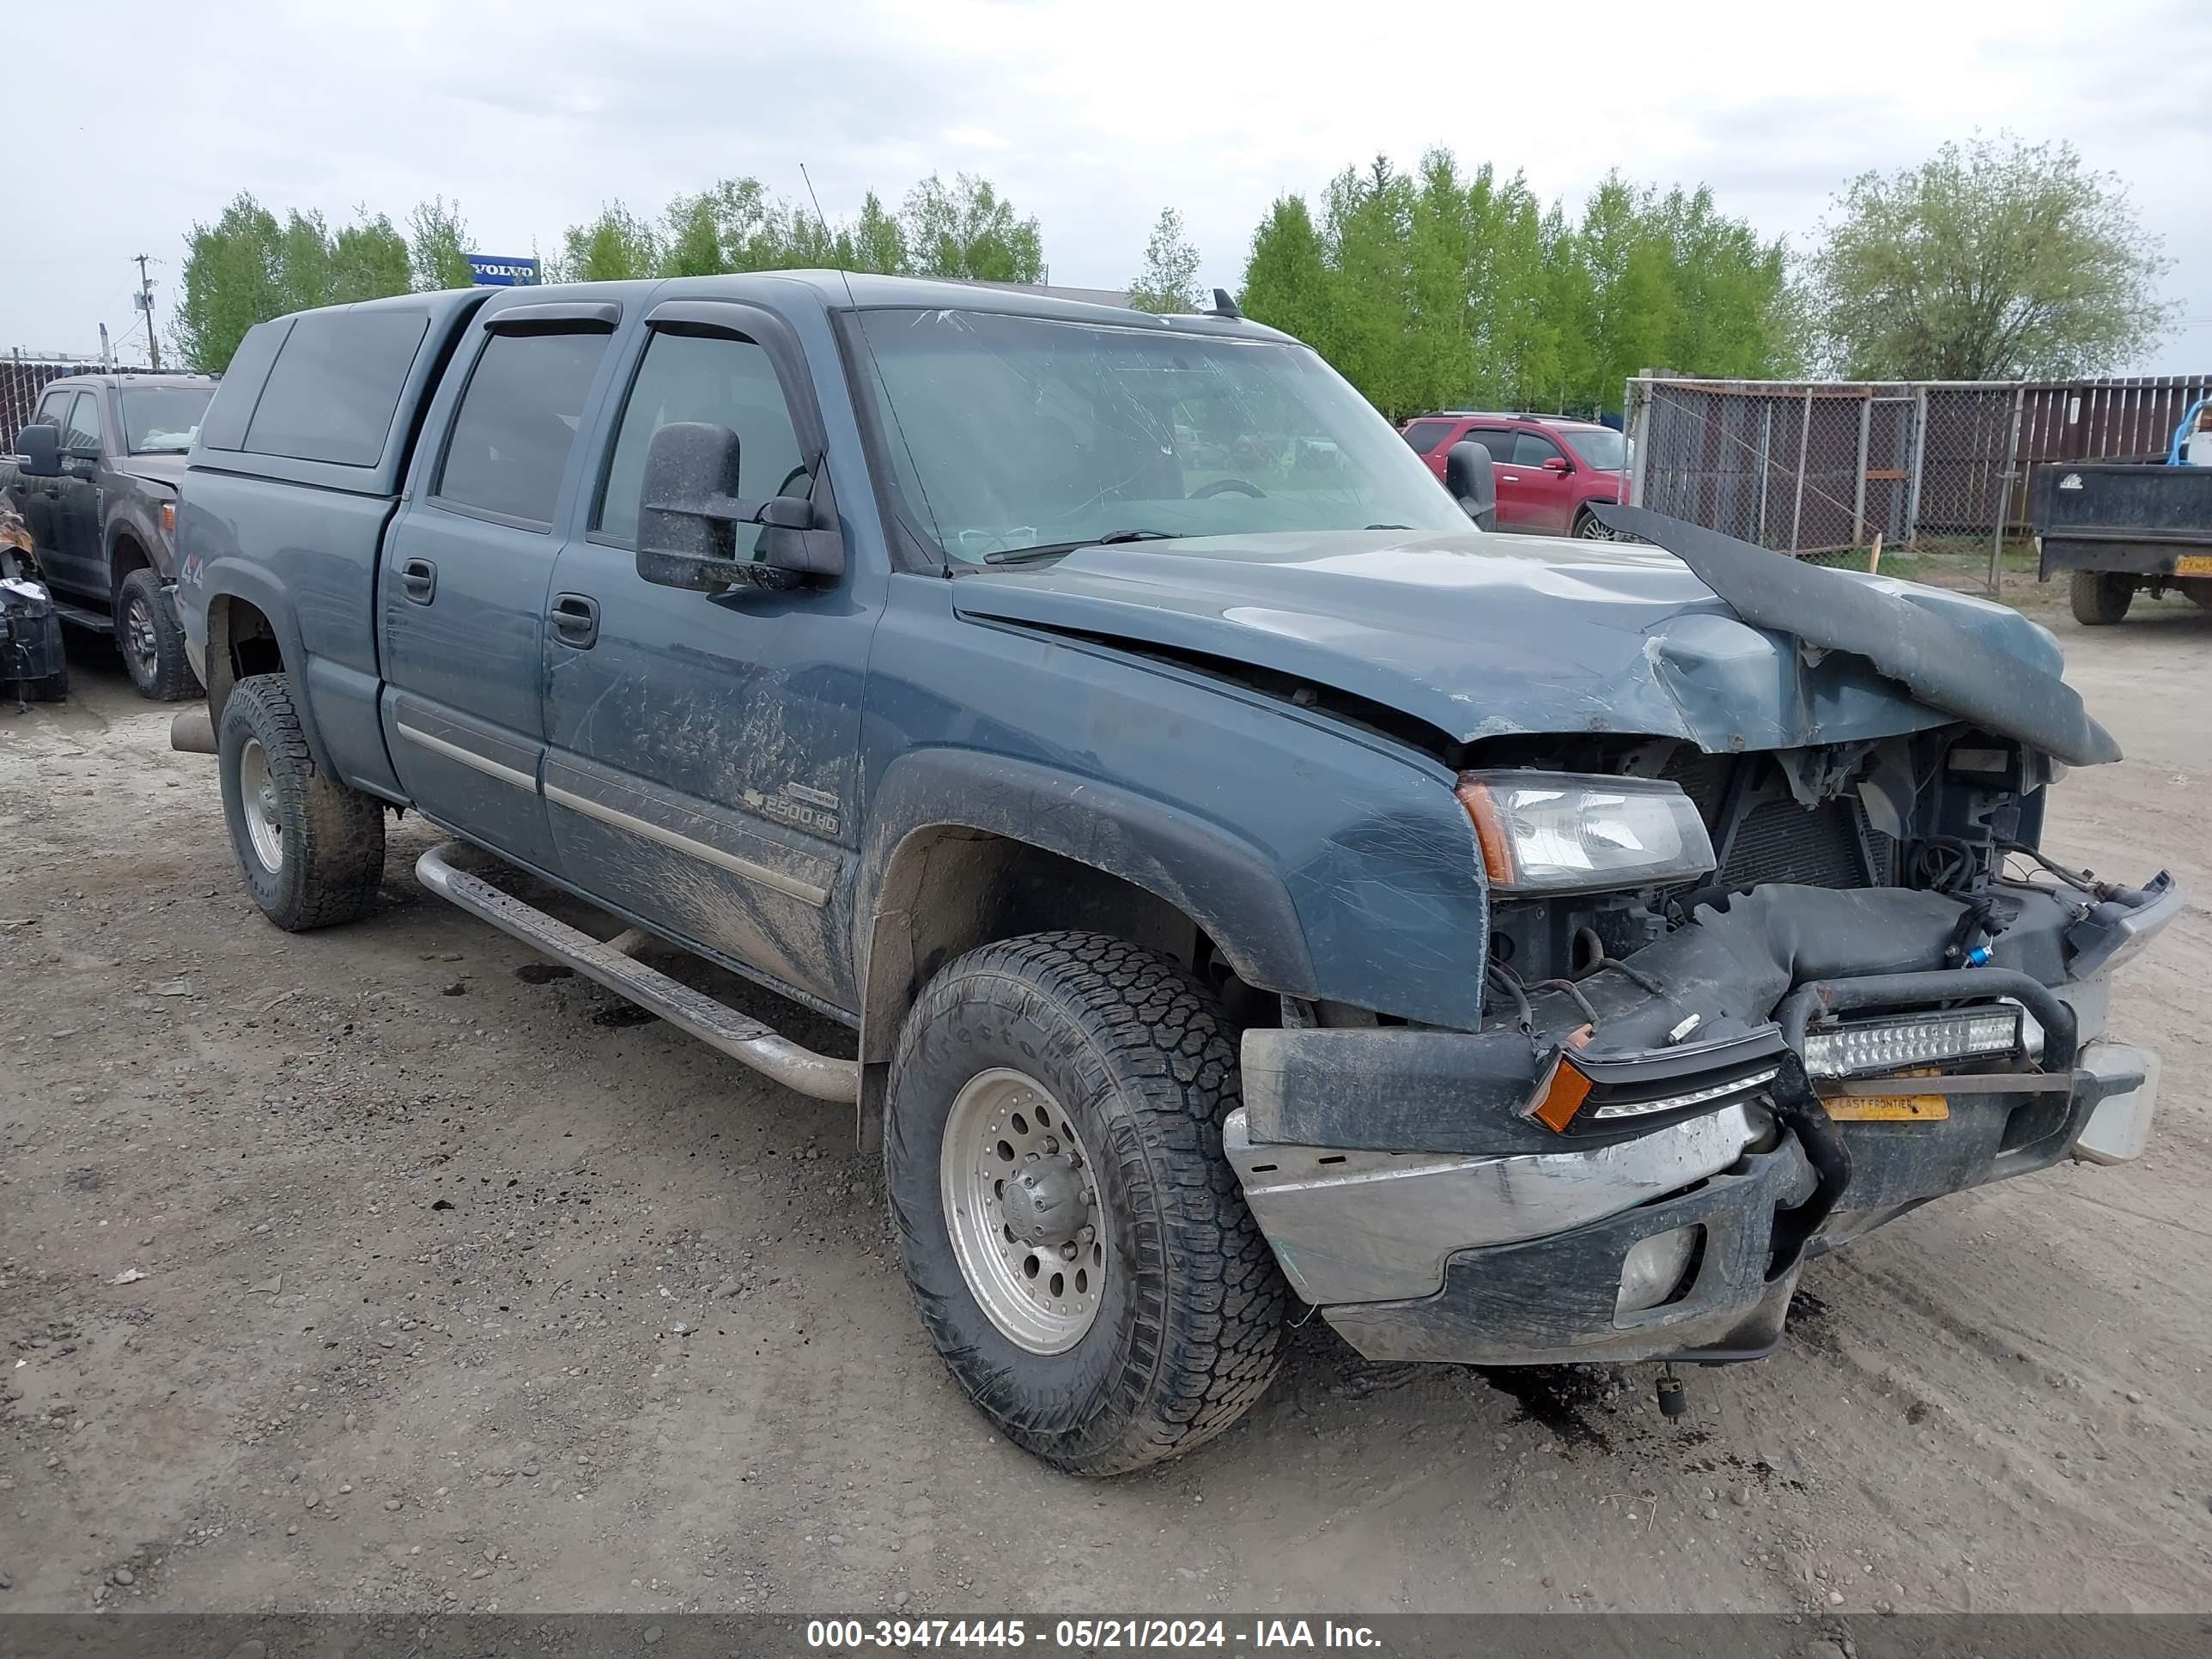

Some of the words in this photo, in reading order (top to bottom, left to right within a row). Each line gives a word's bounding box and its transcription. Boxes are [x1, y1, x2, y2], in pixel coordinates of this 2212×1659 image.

[470, 263, 533, 277] VOLVO
[765, 796, 814, 824] 2500
[816, 812, 840, 835] HD
[1839, 1098, 1866, 1109] LAST
[1869, 1098, 1912, 1109] FRONTIER
